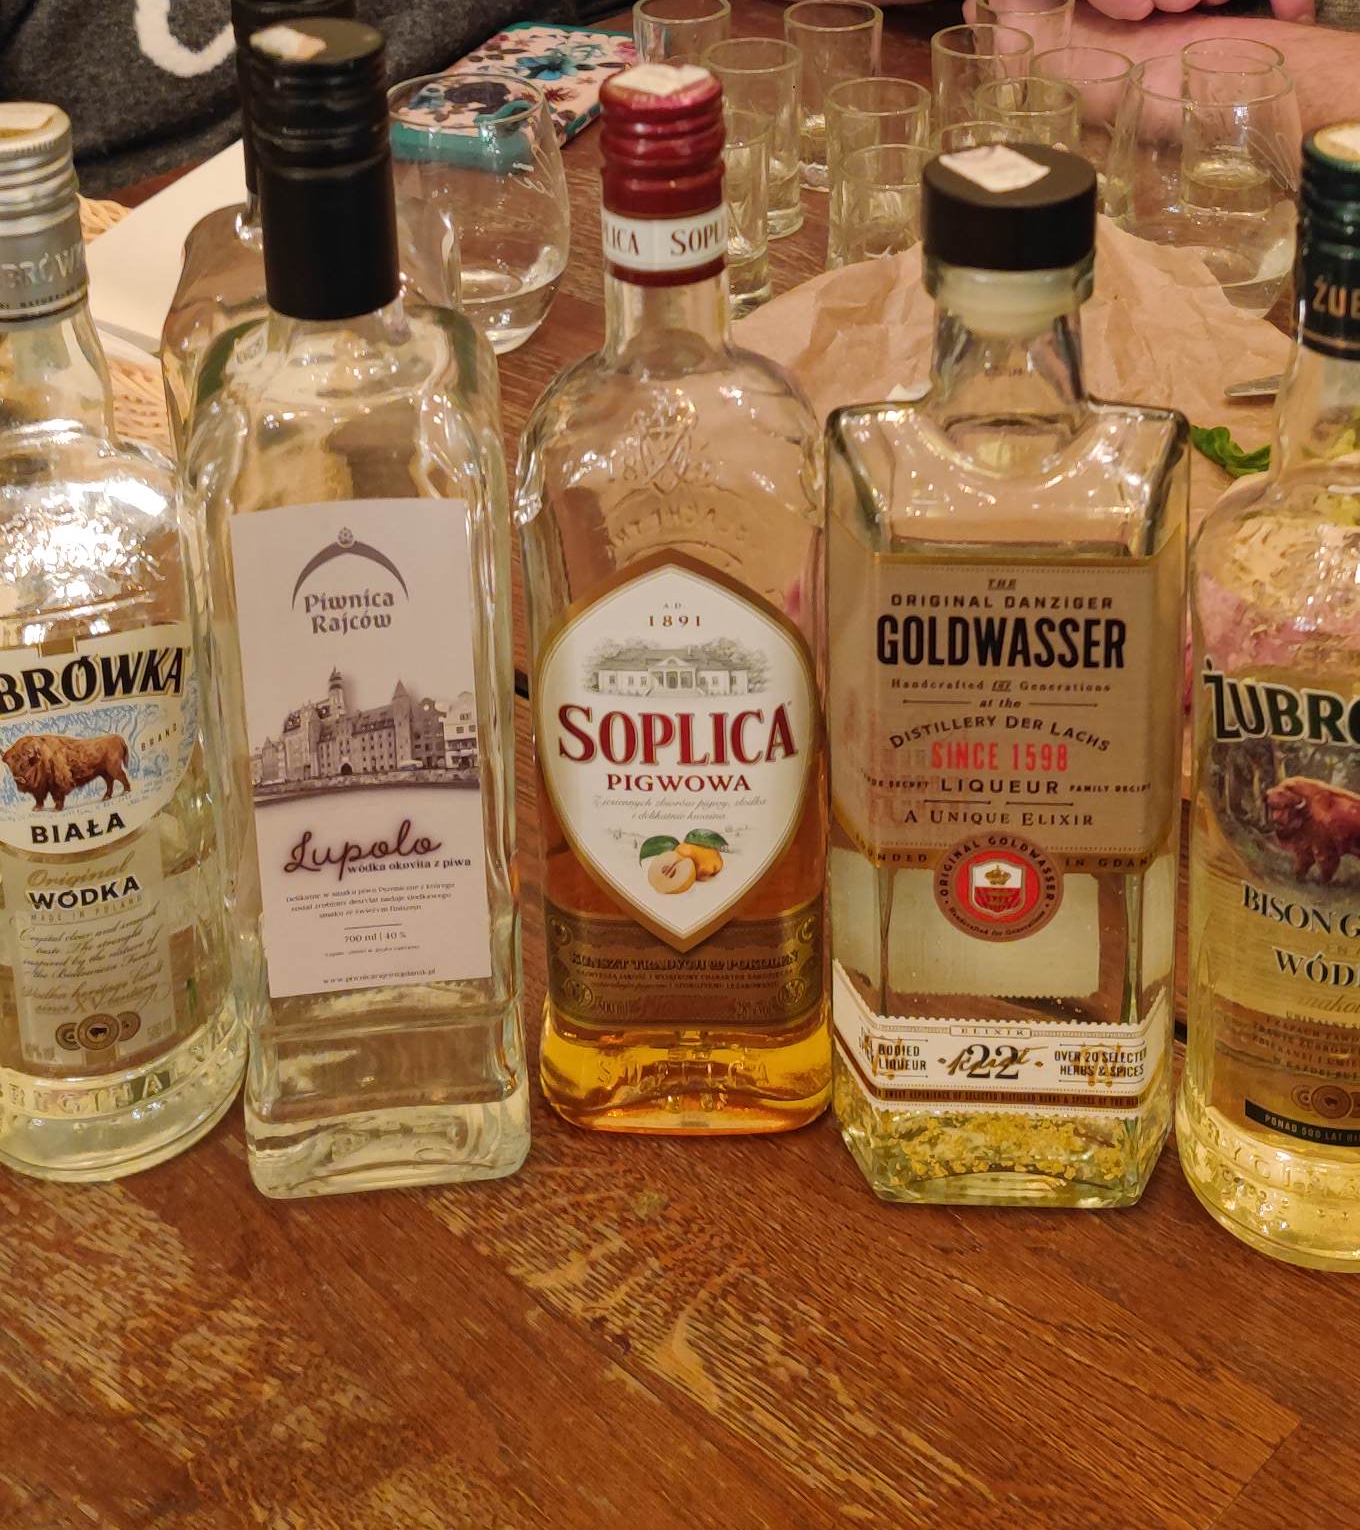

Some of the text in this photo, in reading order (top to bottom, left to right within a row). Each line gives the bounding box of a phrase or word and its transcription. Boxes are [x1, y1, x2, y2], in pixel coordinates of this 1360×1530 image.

[604, 221, 641, 257] LICA
[670, 218, 725, 257] SOPL
[988, 579, 1017, 590] THE
[304, 588, 395, 613] Piwnica
[891, 594, 1113, 609] ORIGINAL DANZIGER
[311, 610, 392, 636] Rajców
[649, 614, 701, 627] 1891
[877, 614, 1127, 669] GOLDWASSER
[891, 679, 984, 690] Handcrafted
[1019, 680, 1111, 692] Generations
[979, 698, 1022, 708] at the
[558, 702, 799, 766] SOPLICA
[889, 715, 1111, 752] DISTILLERY DER LACHS
[931, 742, 1069, 772] SINCE 1598
[607, 774, 752, 792] PIGWOWA
[941, 778, 1059, 793] LIQUEUR
[1069, 784, 1110, 793] FAMILY
[30, 812, 126, 844] BIAŁA
[904, 810, 1094, 826] A UNIQUE ELIXIR
[283, 819, 442, 881] Lupolo
[1065, 857, 1085, 867] IN
[26, 851, 136, 887] Original
[347, 863, 386, 874] wódka
[443, 858, 472, 869] piwa
[939, 836, 1056, 901] ORIGINAL GOLDWASSER
[28, 874, 141, 911] WÓDKA
[31, 913, 62, 922] MADE
[95, 897, 142, 916] POLAND
[1241, 880, 1334, 935] BISON
[878, 1043, 921, 1056] BODIED
[966, 1044, 1019, 1079] 22
[1054, 1050, 1081, 1063] OVER
[1085, 1050, 1099, 1063] 20
[878, 1059, 927, 1071] LIQUEUR
[1060, 1063, 1144, 1078] HERBS & SPICES
[1263, 1113, 1298, 1135] PONAD
[1301, 1126, 1322, 1141] 500
[1325, 1129, 1343, 1142] LAT
